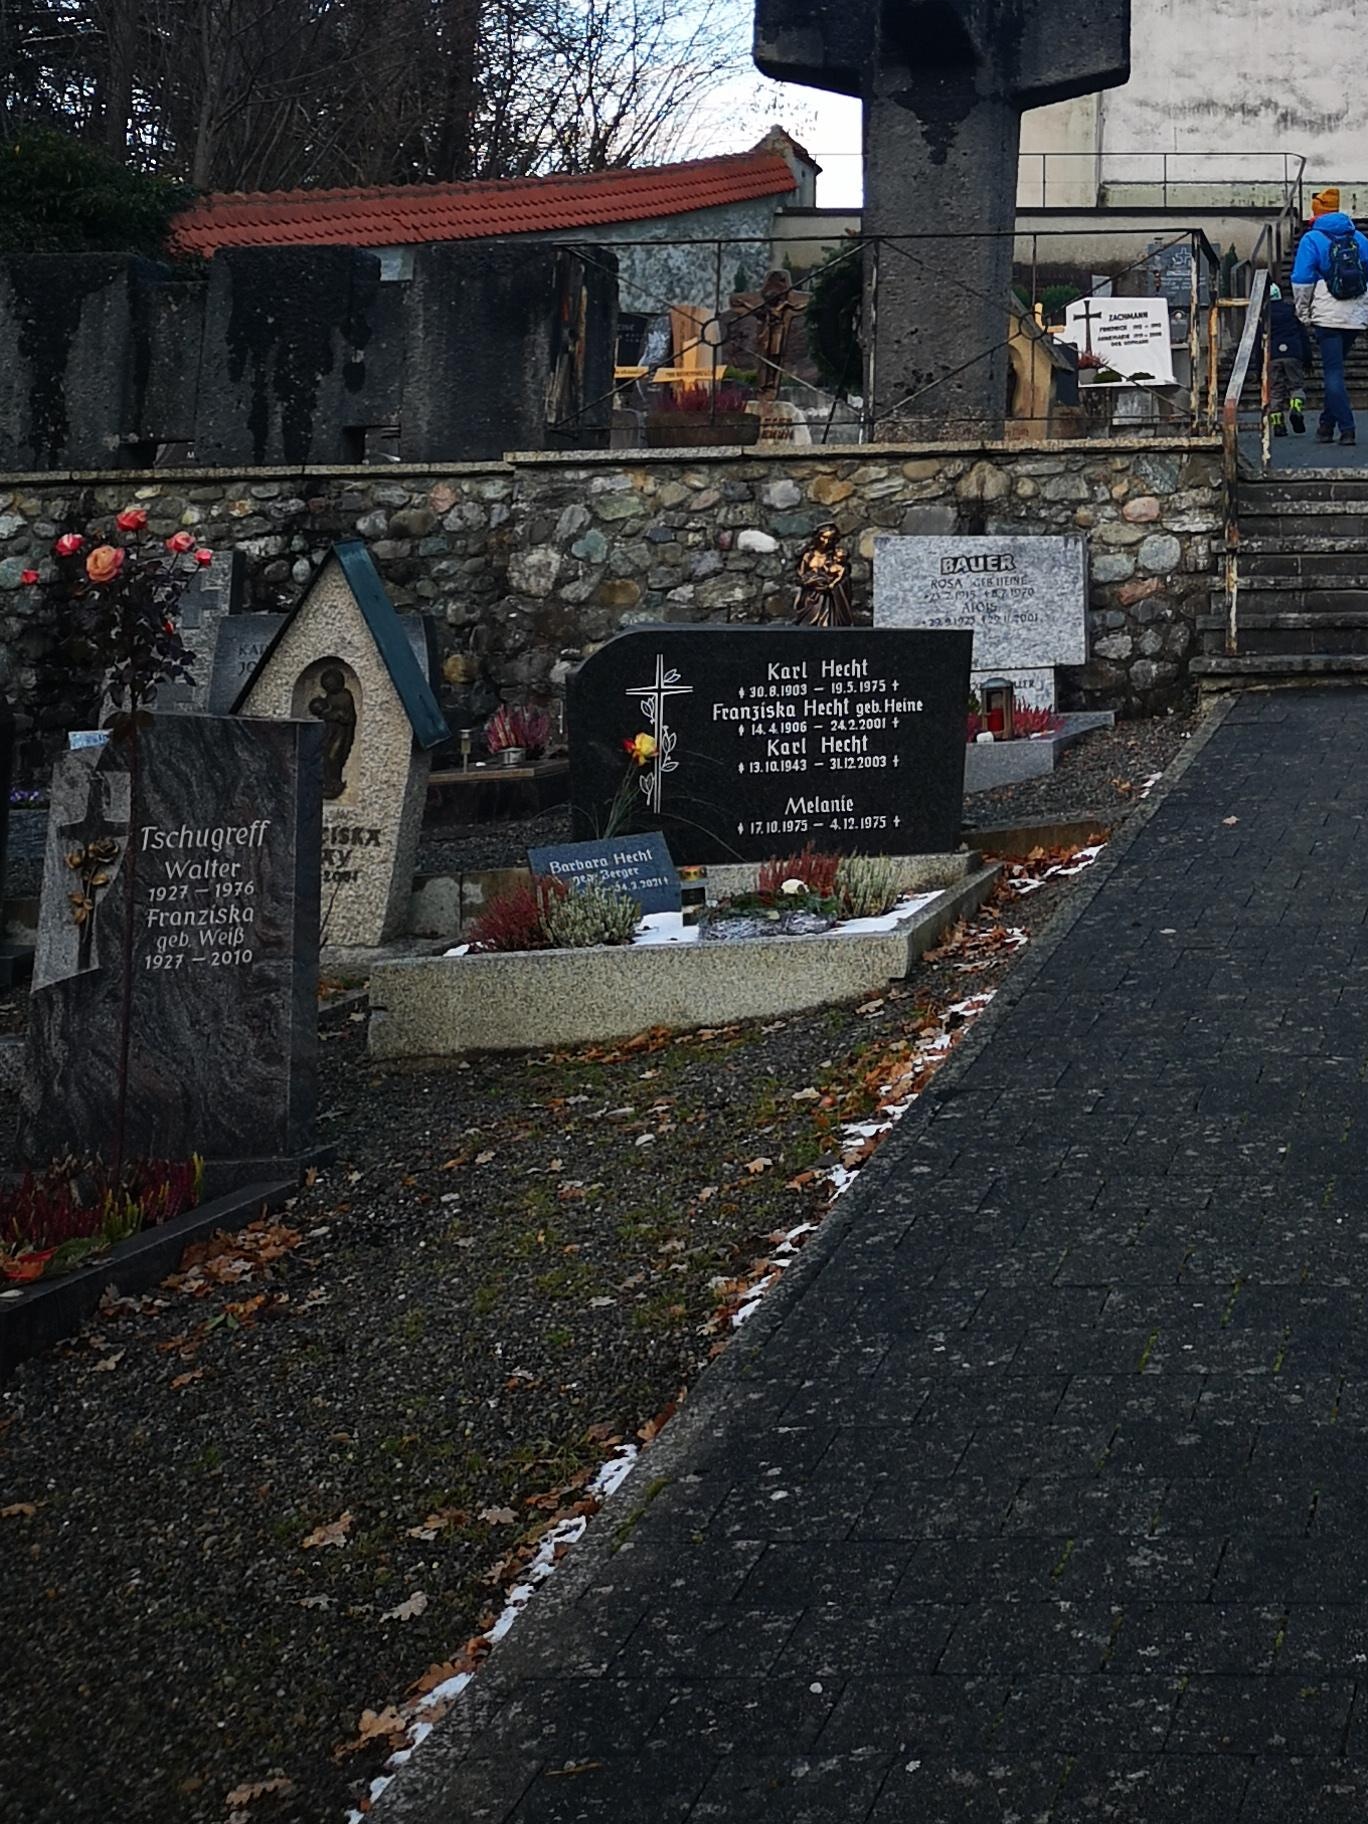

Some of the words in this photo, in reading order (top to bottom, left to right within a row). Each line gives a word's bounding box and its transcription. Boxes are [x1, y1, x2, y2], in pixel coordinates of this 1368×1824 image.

[941, 553, 1016, 575] BAUER
[930, 578, 963, 589] ROSA
[767, 660, 808, 681] Karl
[821, 658, 869, 678] Hecht
[749, 683, 808, 698] 30.8.1903
[831, 679, 887, 695] 19.5.1975
[713, 700, 796, 721] Franziska
[804, 696, 850, 717] Hecht
[884, 697, 924, 714] Heine
[751, 721, 808, 736] 14.4.1906
[830, 717, 887, 732] 24.2.2001
[766, 737, 807, 757] Karl
[821, 734, 869, 755] Hecht
[749, 758, 808, 773] 13.10.1943
[784, 794, 854, 816] Melanie
[141, 819, 272, 853] Tschugreff
[750, 819, 808, 835] 17.10.1975
[829, 815, 887, 831] 4.12.1975
[165, 858, 242, 880] Walter
[549, 857, 609, 875] Barbara
[612, 848, 654, 866] Hecht
[149, 884, 190, 903] 1927
[215, 879, 256, 898] 1976
[147, 903, 255, 929] Franziska
[156, 931, 192, 954] geb.
[199, 926, 245, 948] Weiß
[145, 953, 185, 970] 1927
[211, 948, 254, 967] 2010
